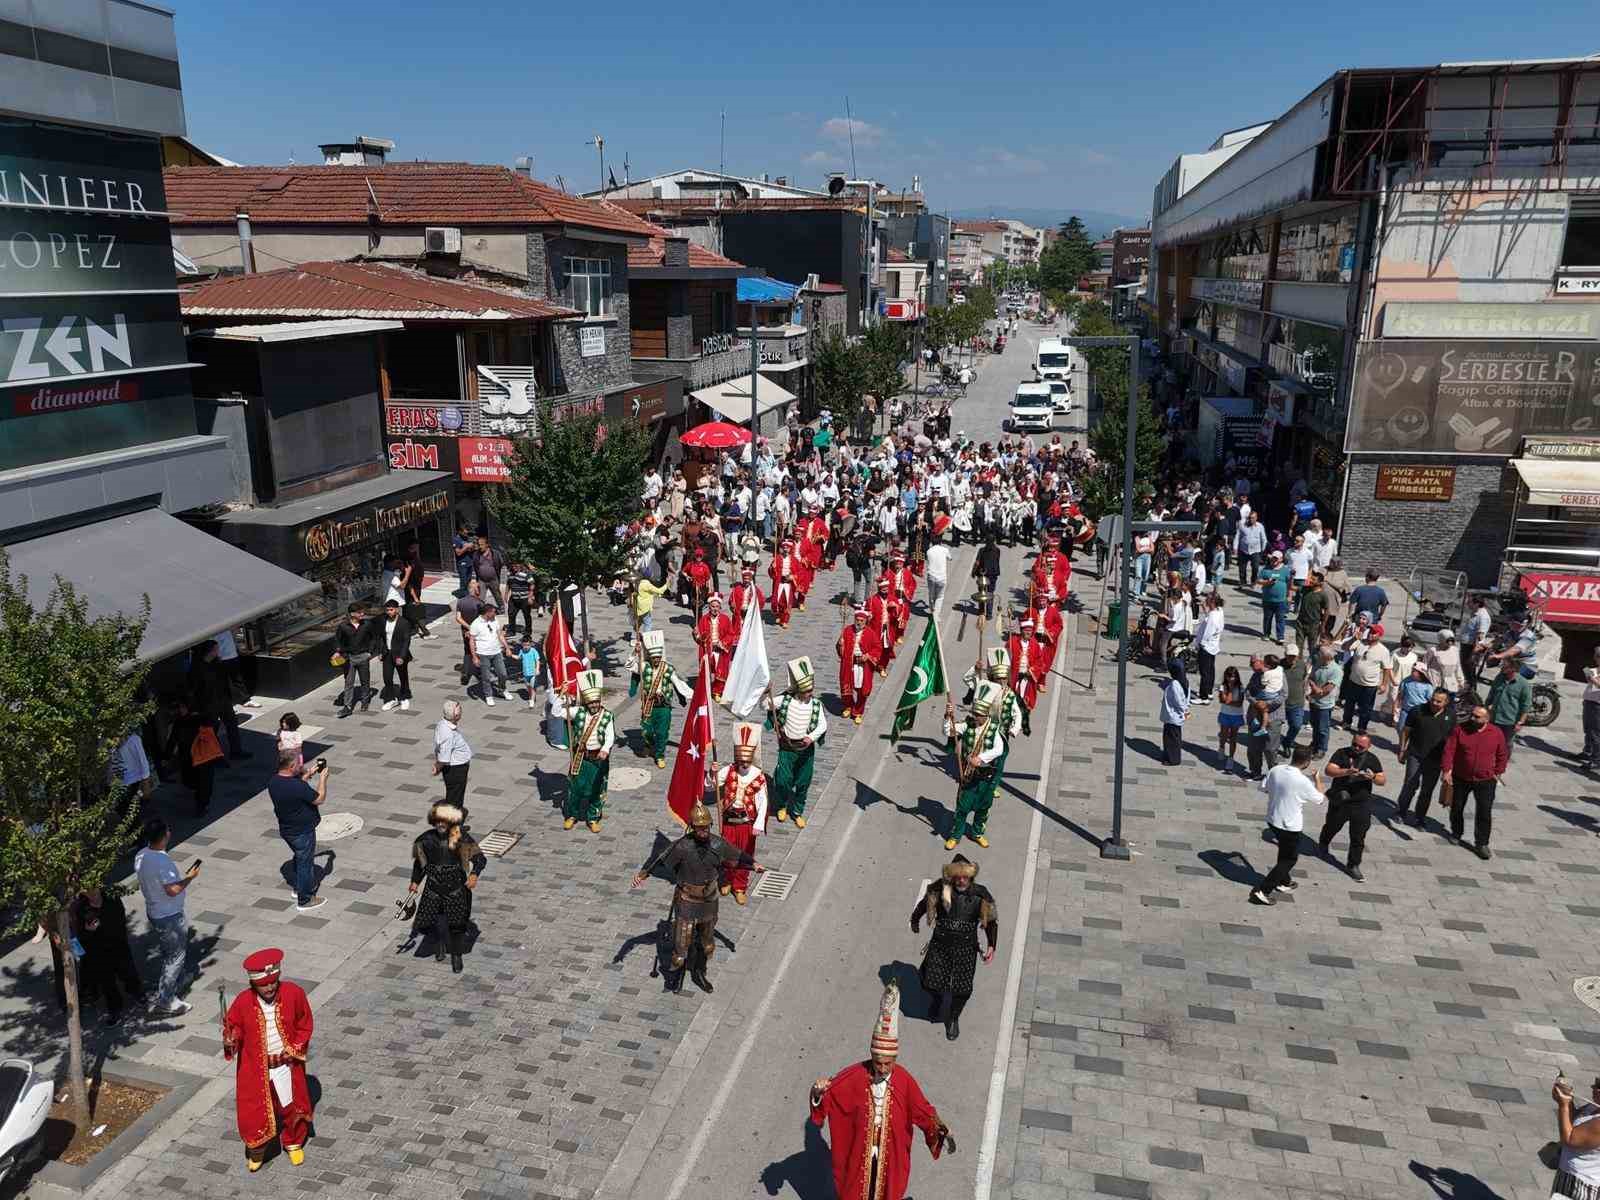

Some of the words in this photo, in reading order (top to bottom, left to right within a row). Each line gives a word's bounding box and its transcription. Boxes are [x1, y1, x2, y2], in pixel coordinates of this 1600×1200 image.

[0, 231, 121, 269] OPEZ
[2, 312, 134, 381] ZEN
[1439, 350, 1576, 381] SERBESLER
[31, 380, 121, 411] diamond
